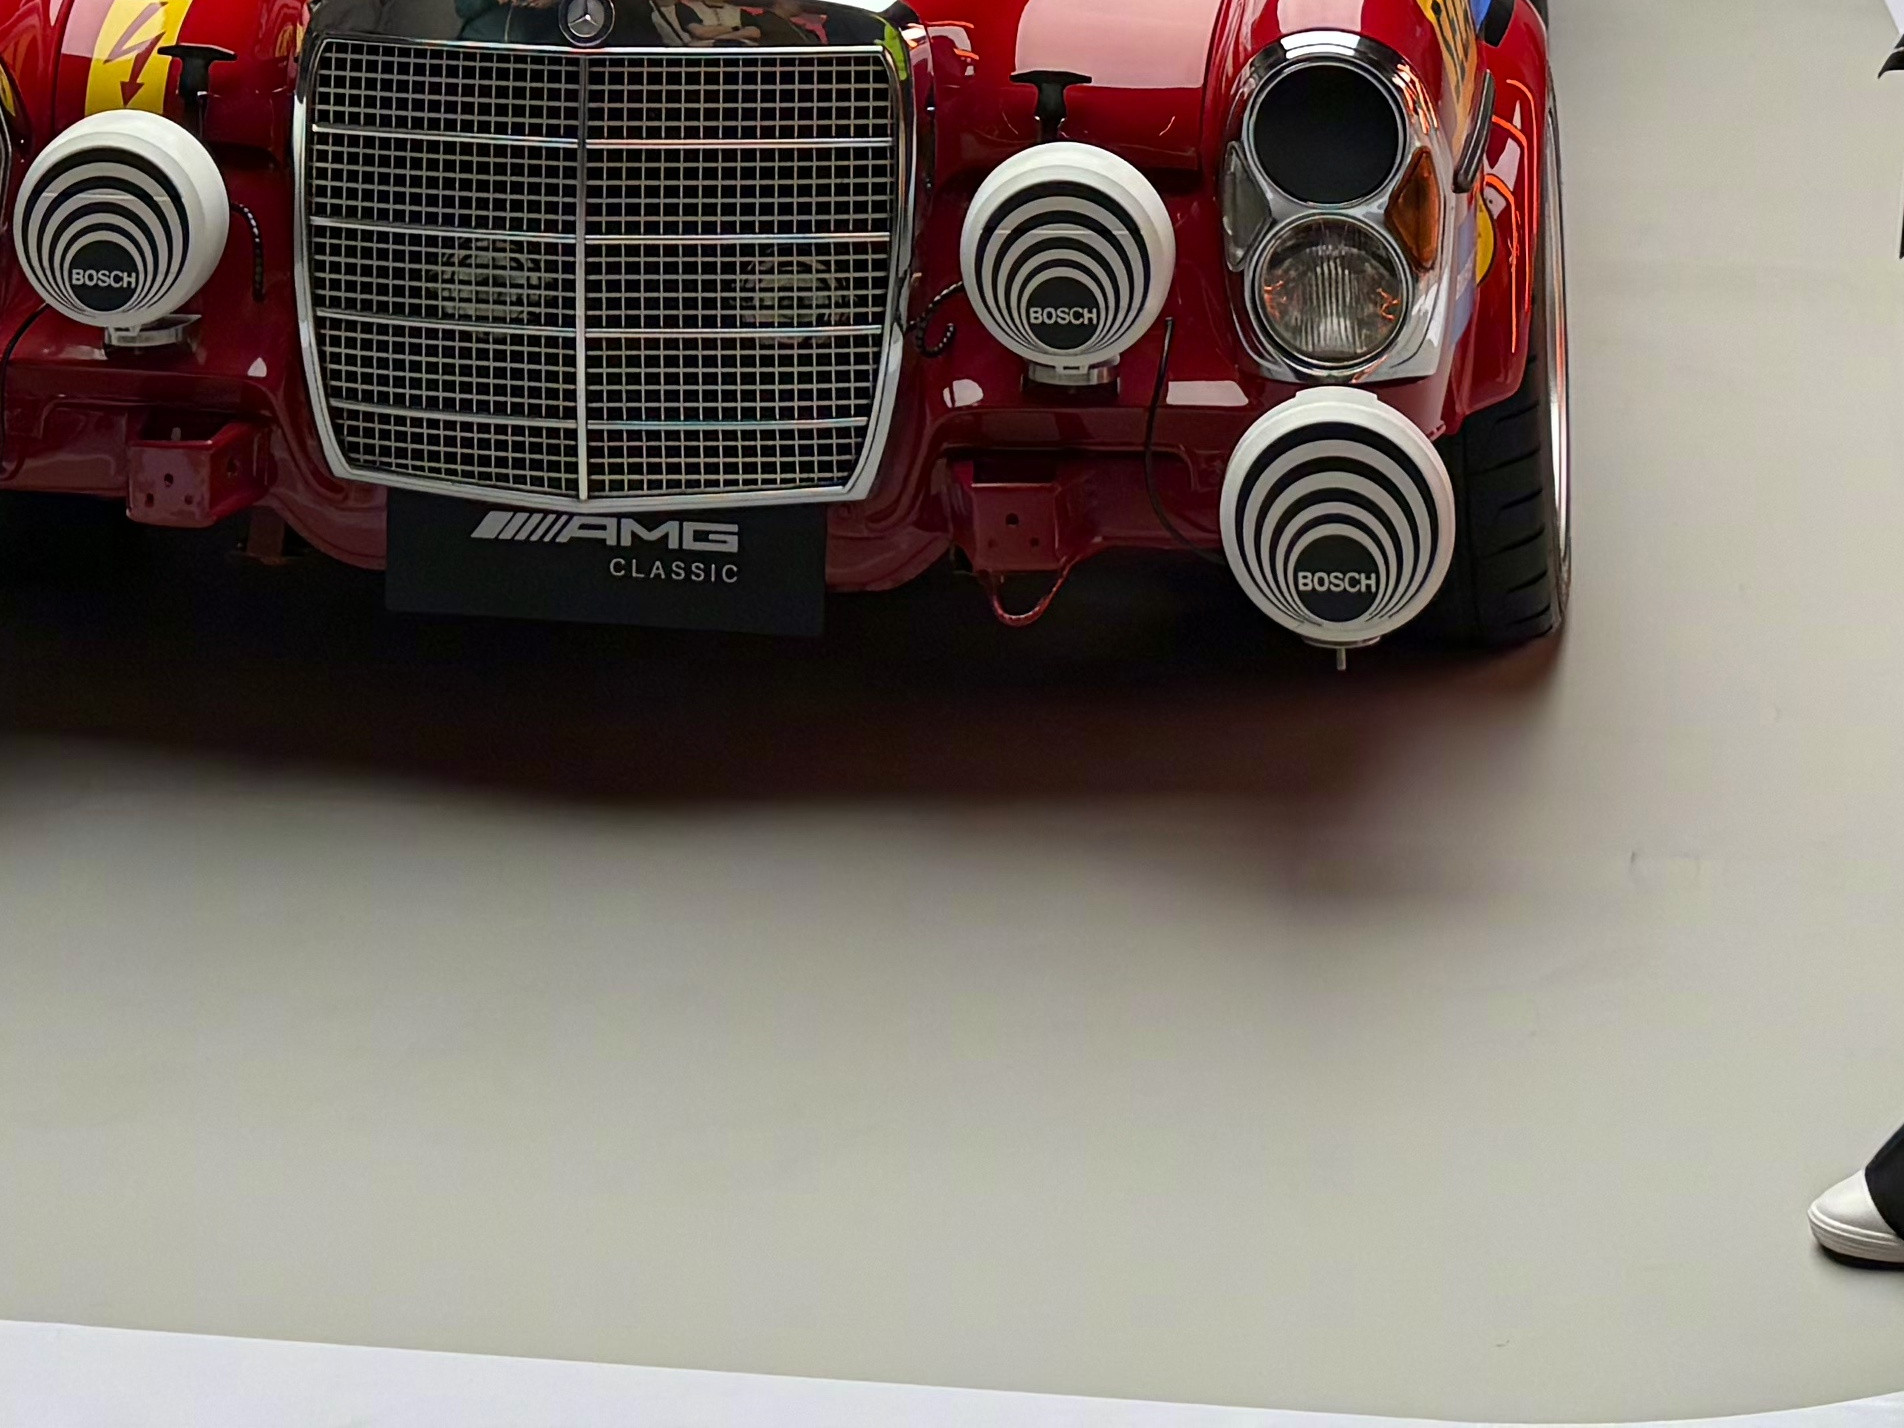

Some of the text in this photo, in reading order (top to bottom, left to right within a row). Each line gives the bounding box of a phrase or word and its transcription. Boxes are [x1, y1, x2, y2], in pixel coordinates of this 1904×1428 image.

[71, 268, 137, 290] BOSCH
[1028, 306, 1098, 325] BOSCH
[555, 513, 739, 554] AMG
[609, 557, 739, 584] CLASSIC
[1297, 570, 1377, 594] BOSCH
